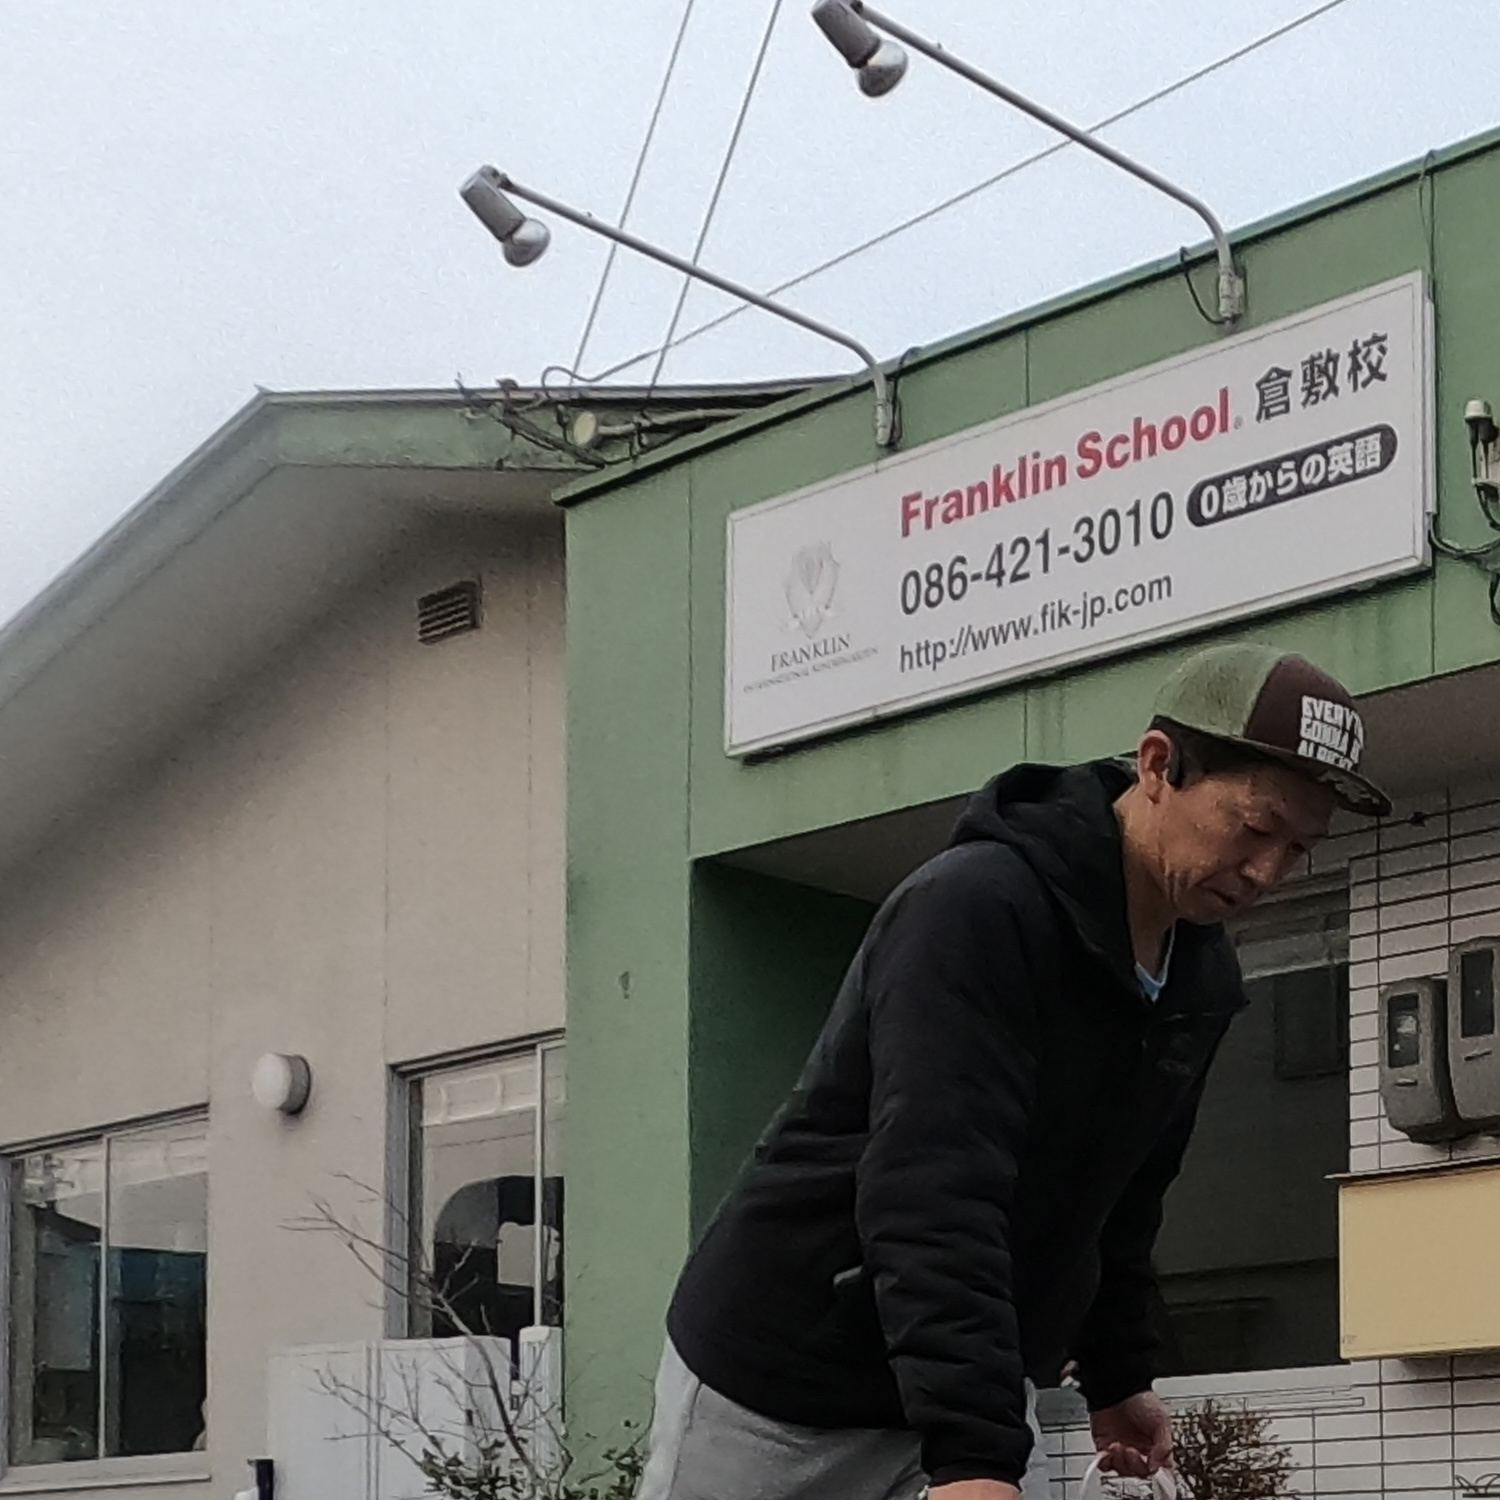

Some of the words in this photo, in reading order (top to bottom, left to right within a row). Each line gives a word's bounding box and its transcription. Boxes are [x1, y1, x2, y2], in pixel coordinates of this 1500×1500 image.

[902, 452, 1067, 537] Franklin
[1076, 386, 1229, 478] School
[1255, 332, 1388, 424] 倉敷校
[1200, 432, 1382, 519] 0歳からの英語
[900, 491, 1173, 615] 086-421-3010
[771, 633, 851, 672] FRANKLIN
[900, 574, 1173, 673] http://www.fik-jp.com
